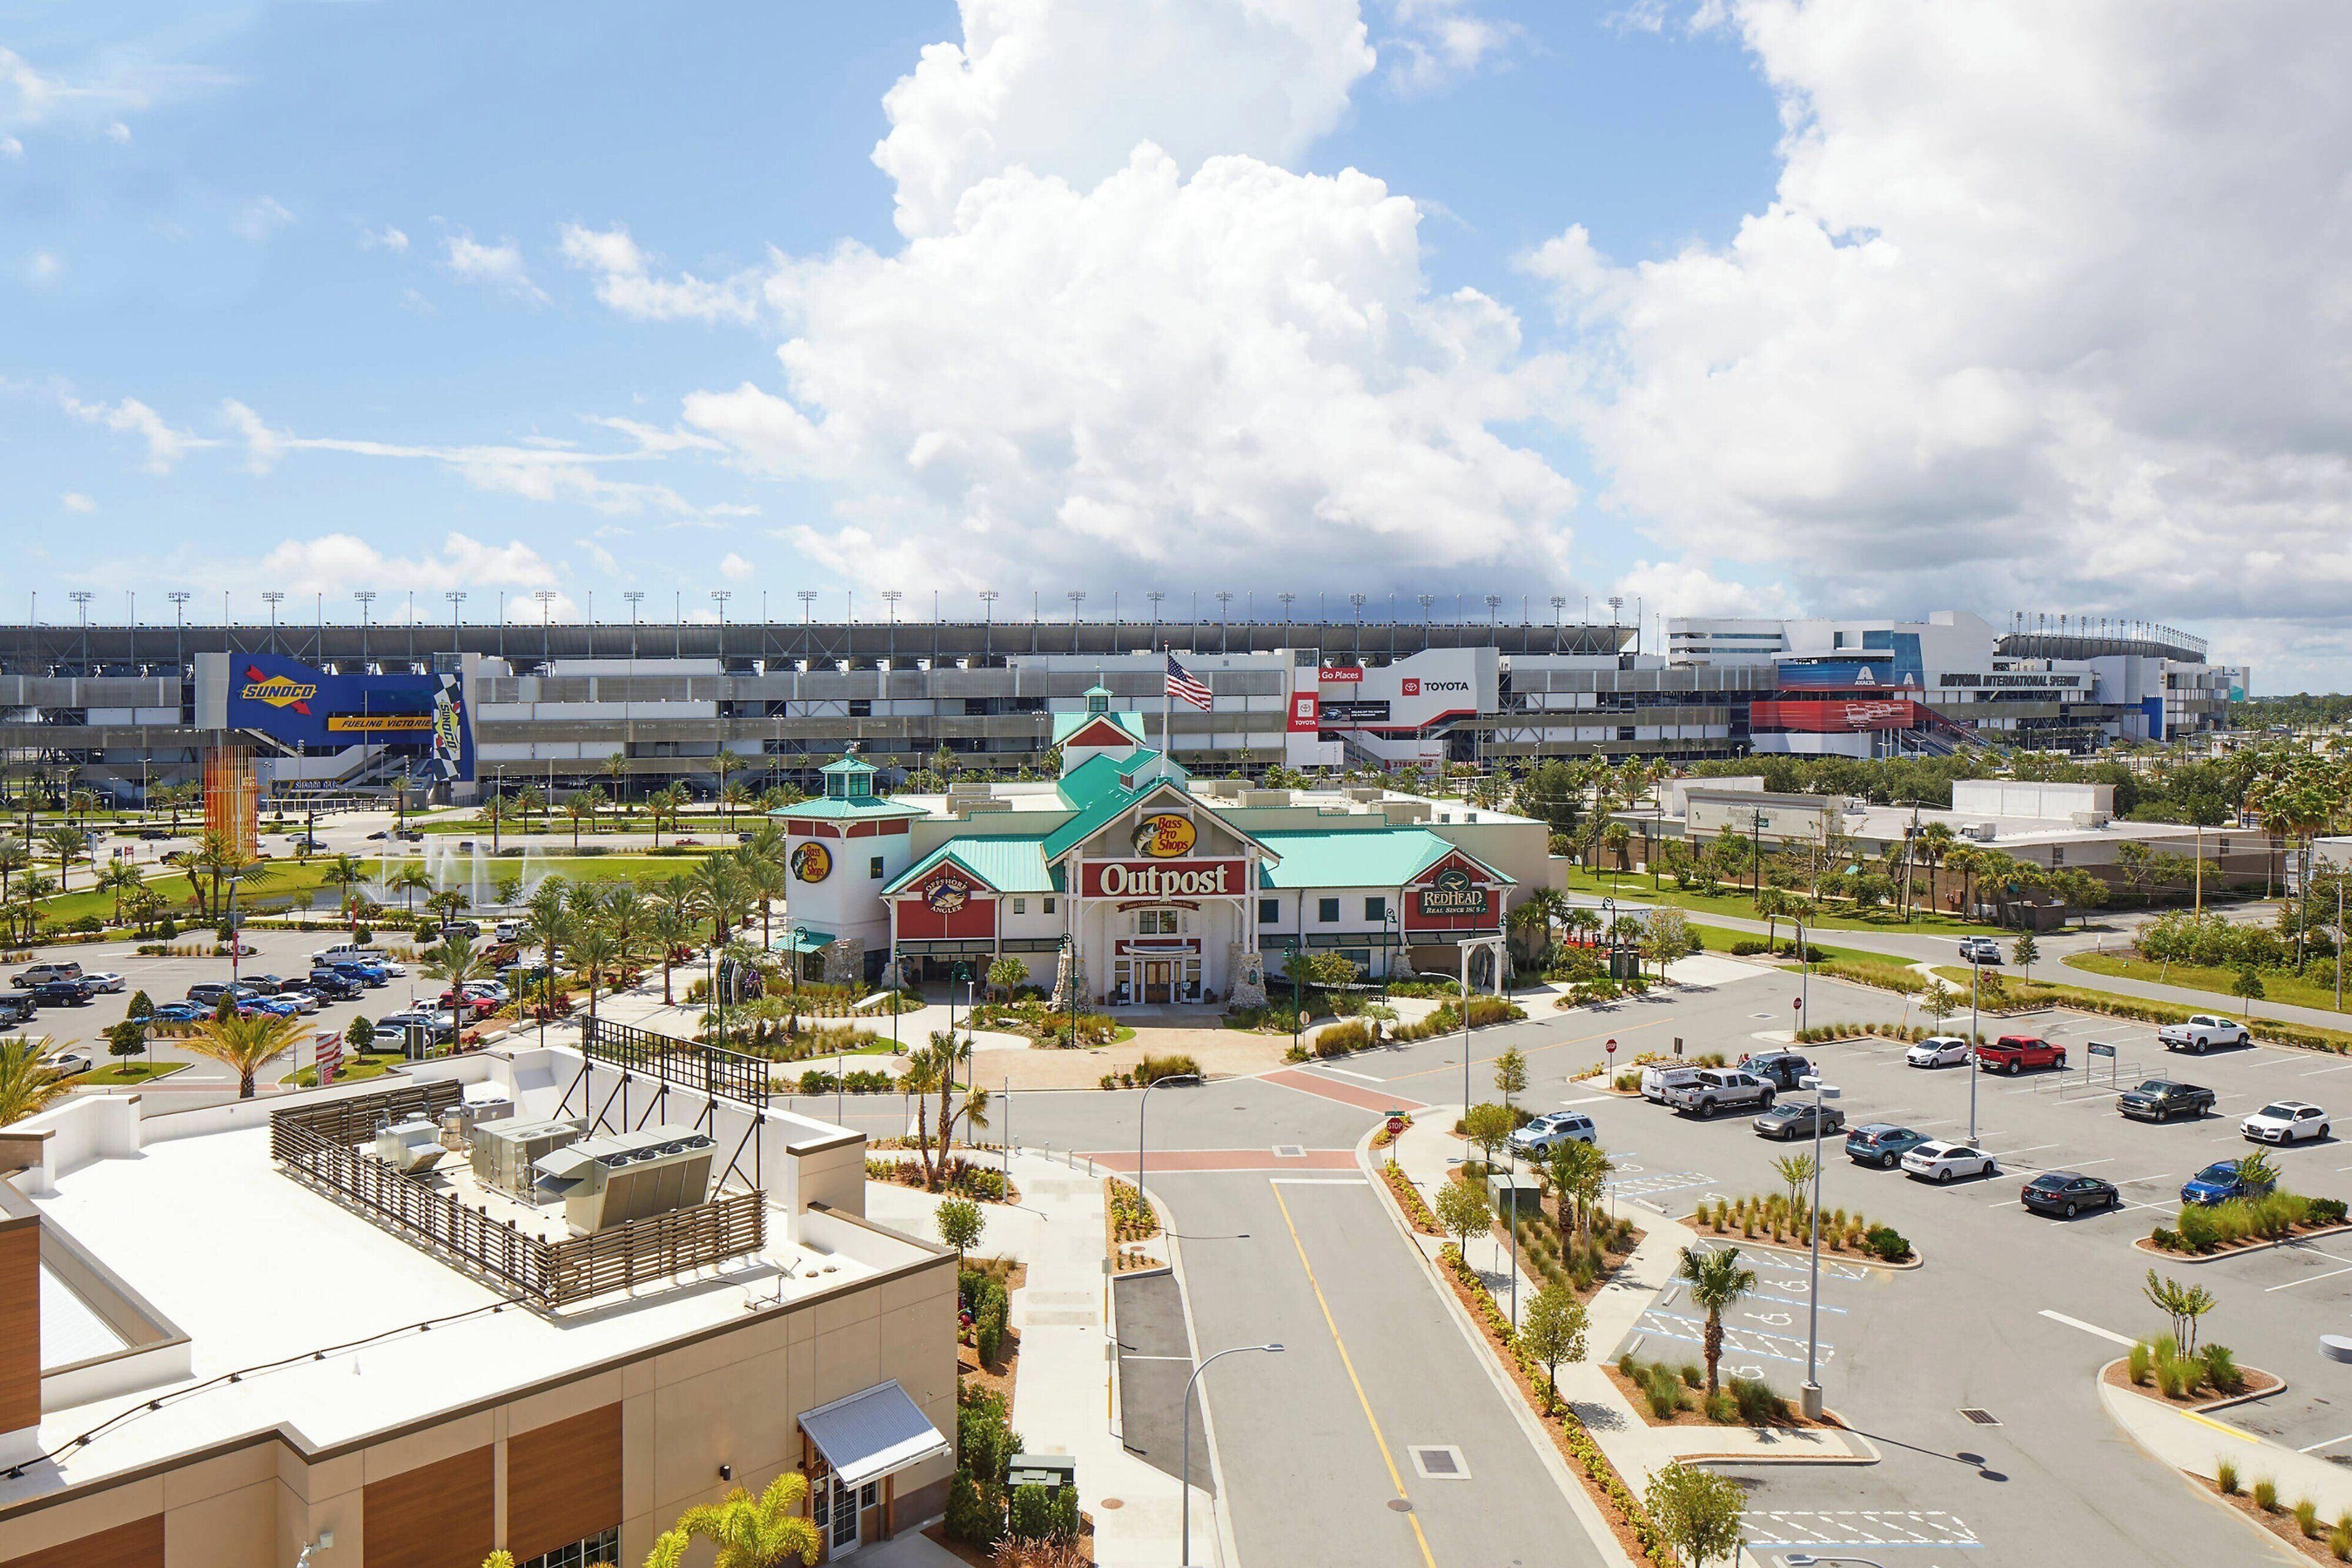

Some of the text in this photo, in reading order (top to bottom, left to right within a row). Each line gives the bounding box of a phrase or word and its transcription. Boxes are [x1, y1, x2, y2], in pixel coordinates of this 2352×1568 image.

[1335, 671, 1359, 679] Places
[1940, 673, 1981, 687] DAYTONA
[1983, 675, 2048, 687] INTERNATIONAL
[245, 685, 314, 698] SUNOCO
[1423, 682, 1469, 692] TOYOTA
[440, 704, 458, 748] SUNOCO
[1158, 816, 1182, 829] Bass
[1158, 829, 1177, 840] Pro
[806, 845, 821, 857] Bass
[1158, 839, 1189, 852] Shops
[806, 864, 824, 878] Shops
[925, 879, 968, 891] OFFSHORE
[1100, 863, 1228, 902] Outpost
[930, 905, 963, 914] ANGLER
